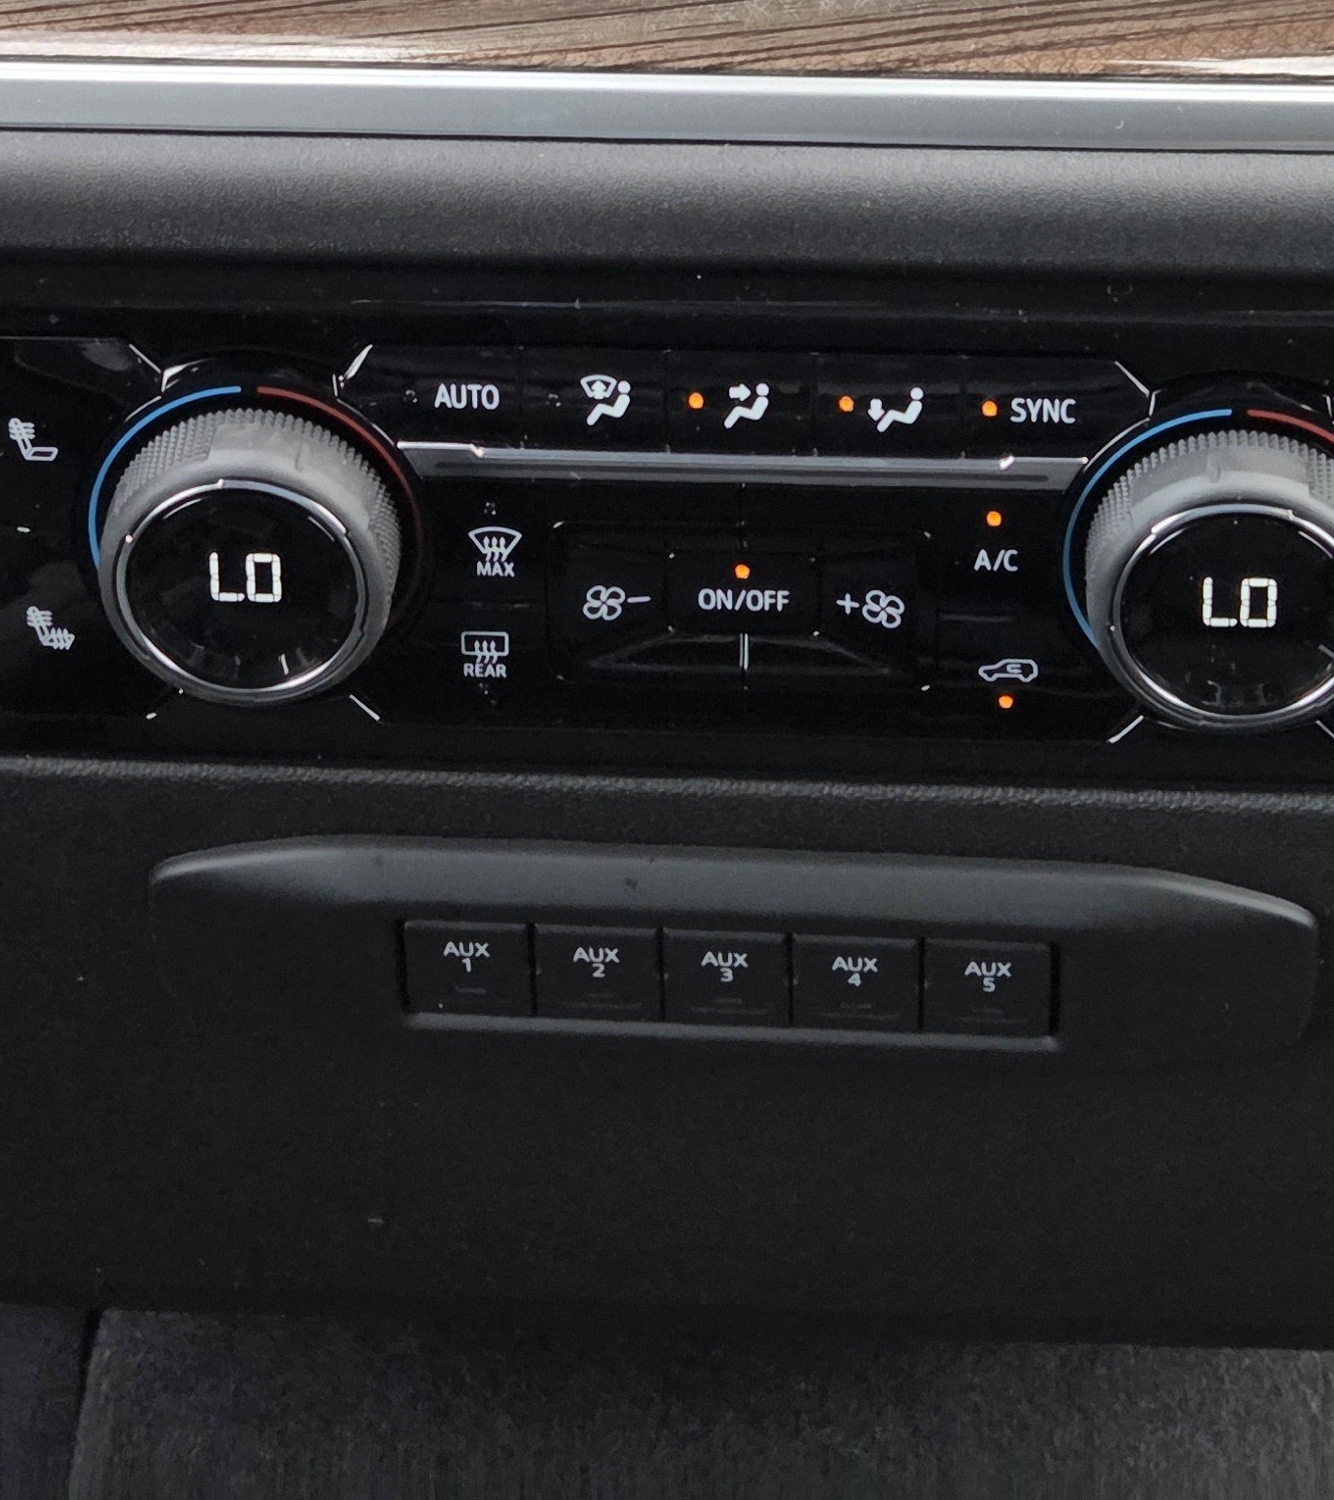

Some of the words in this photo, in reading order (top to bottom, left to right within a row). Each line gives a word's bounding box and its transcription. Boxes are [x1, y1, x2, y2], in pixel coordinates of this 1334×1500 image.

[434, 384, 500, 411] AUTO
[1010, 398, 1076, 425] SYNC
[974, 548, 1019, 573] A/C
[209, 552, 283, 603] LO
[477, 561, 514, 578] MAX
[698, 588, 790, 613] ON/OFF
[1201, 576, 1278, 629] LO
[462, 662, 508, 679] REAR
[442, 942, 490, 958] AUX
[573, 946, 621, 963] AUX
[462, 958, 472, 973] 1
[701, 951, 749, 968] AUX
[831, 956, 879, 972] AUX
[591, 963, 605, 978] 2
[720, 967, 733, 982] 3
[964, 961, 1012, 978] AUX
[848, 972, 862, 987] 4
[983, 977, 995, 992] 5
